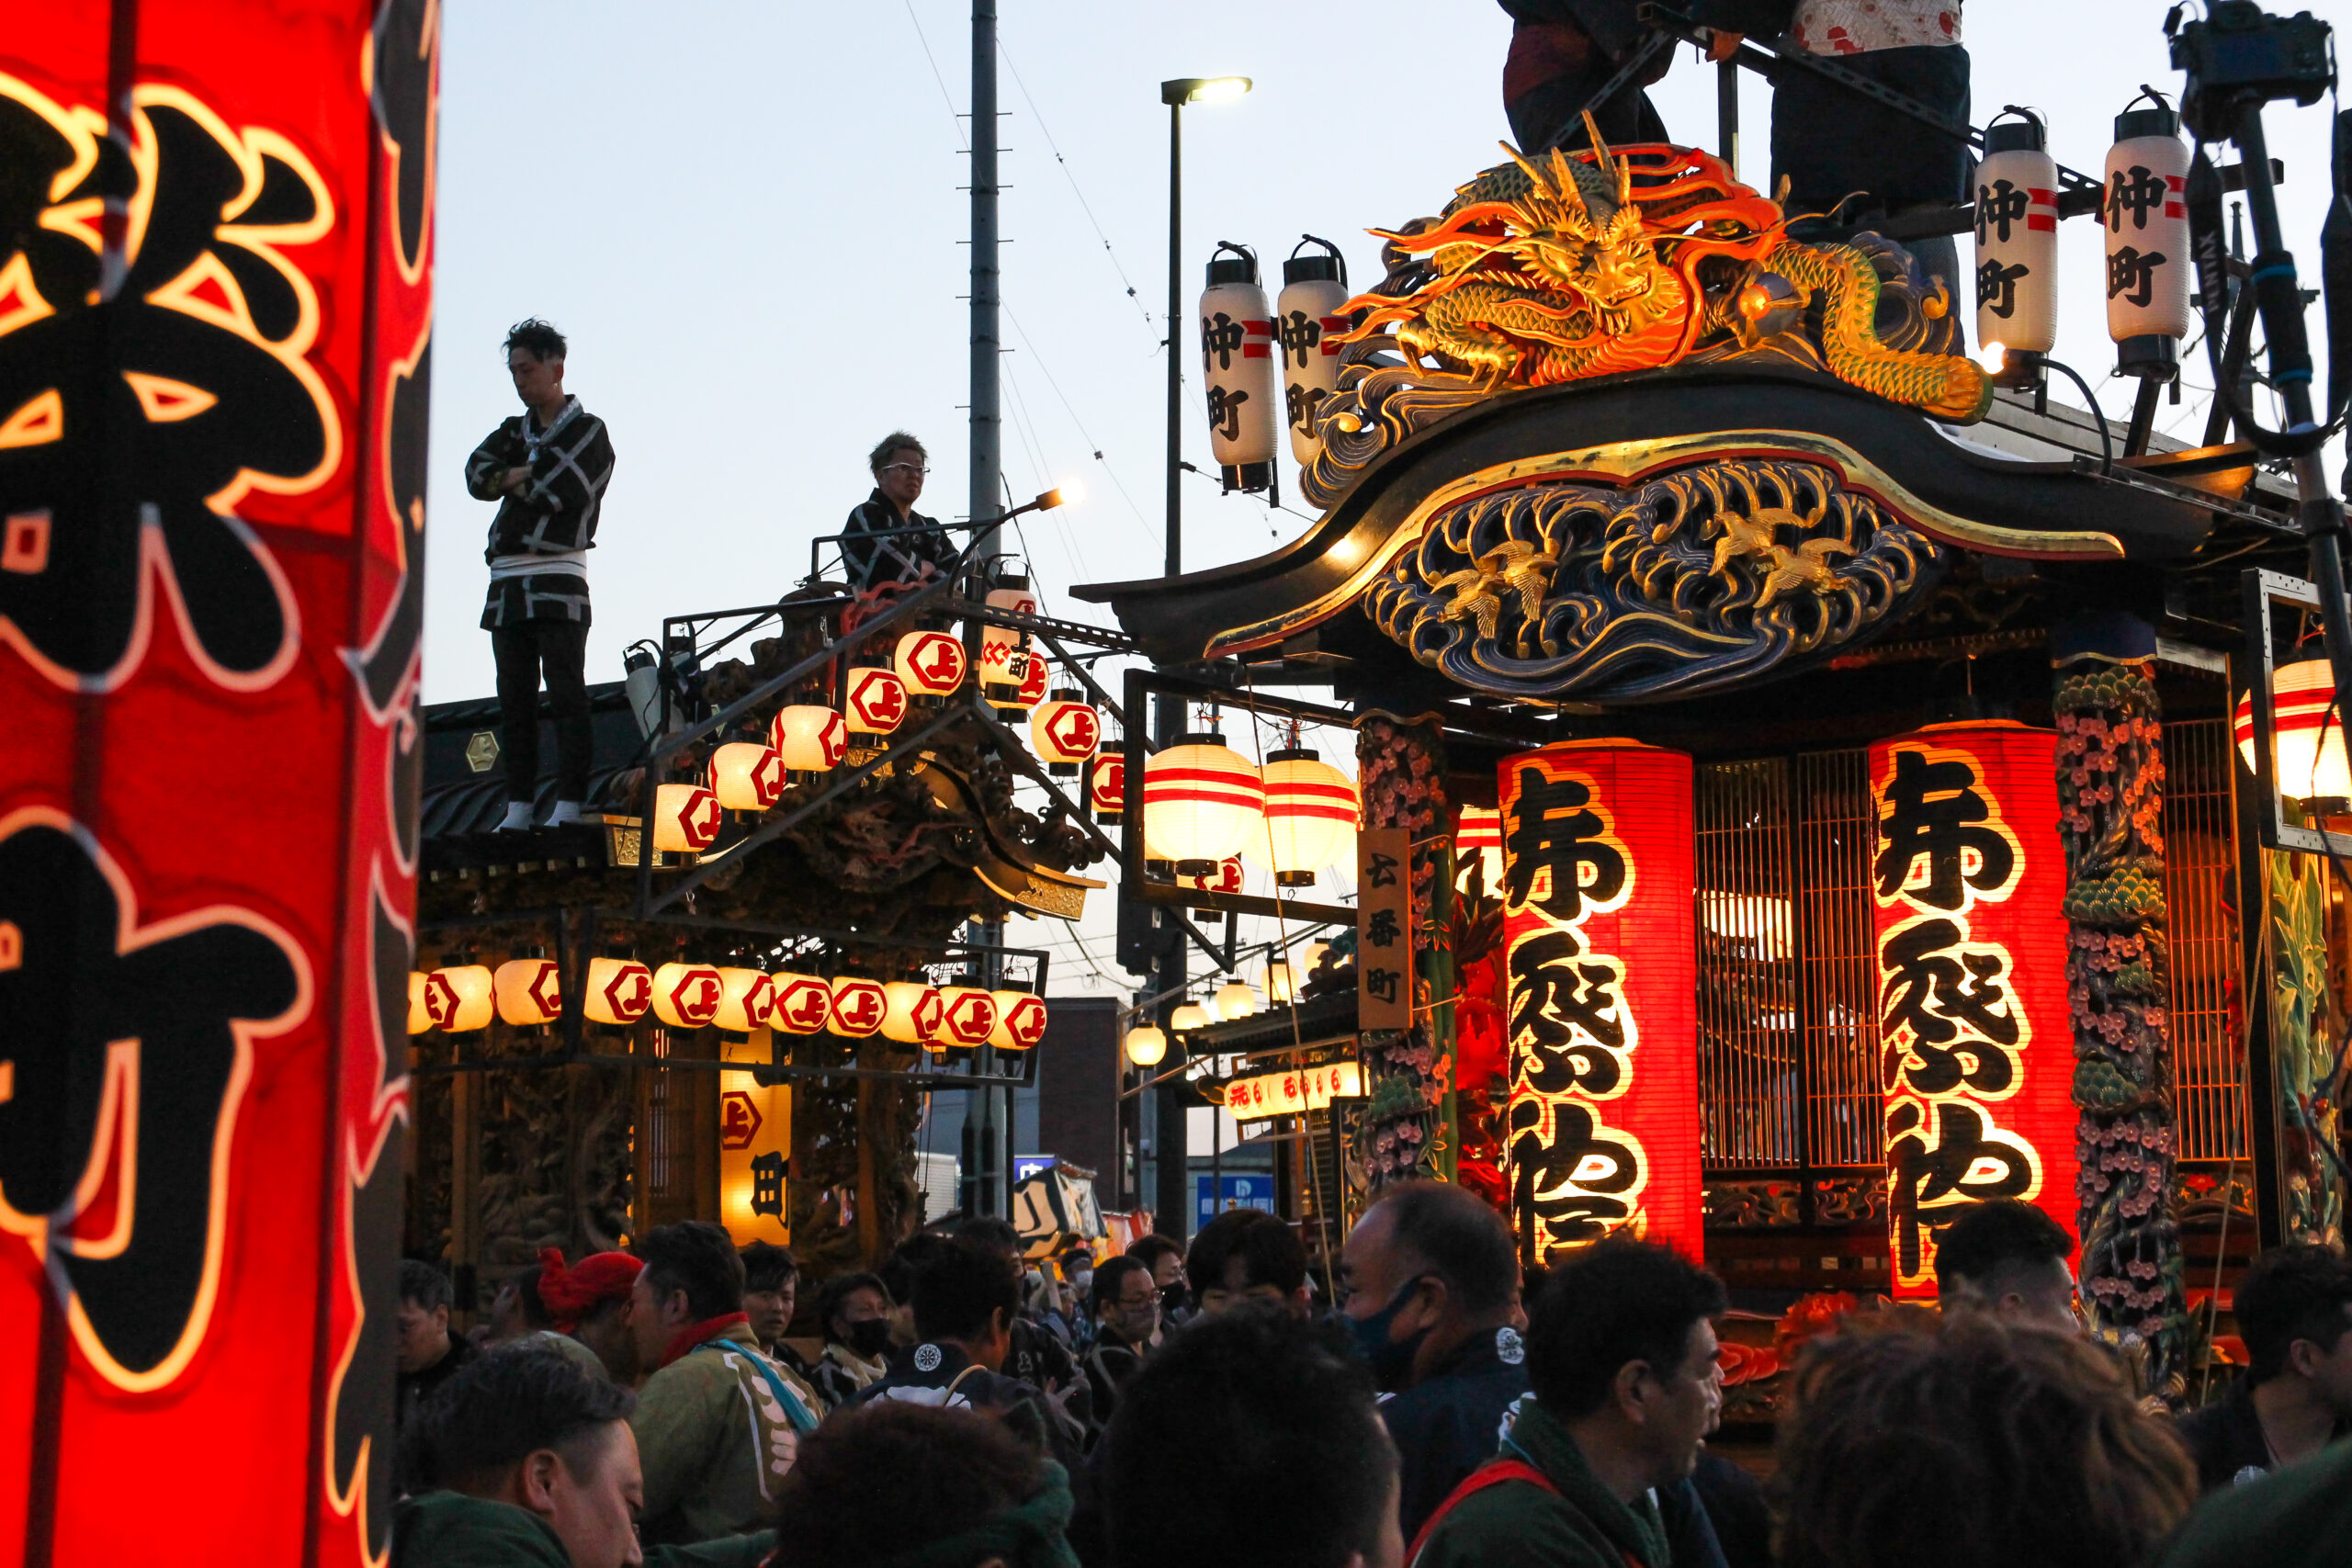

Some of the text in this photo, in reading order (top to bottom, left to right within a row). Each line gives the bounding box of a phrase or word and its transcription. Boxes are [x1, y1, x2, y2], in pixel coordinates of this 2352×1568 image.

[1975, 179, 2030, 319] 仲町
[2105, 165, 2167, 308] 仲町
[1203, 311, 1249, 442] 仲町
[1281, 310, 1327, 439] 仲町
